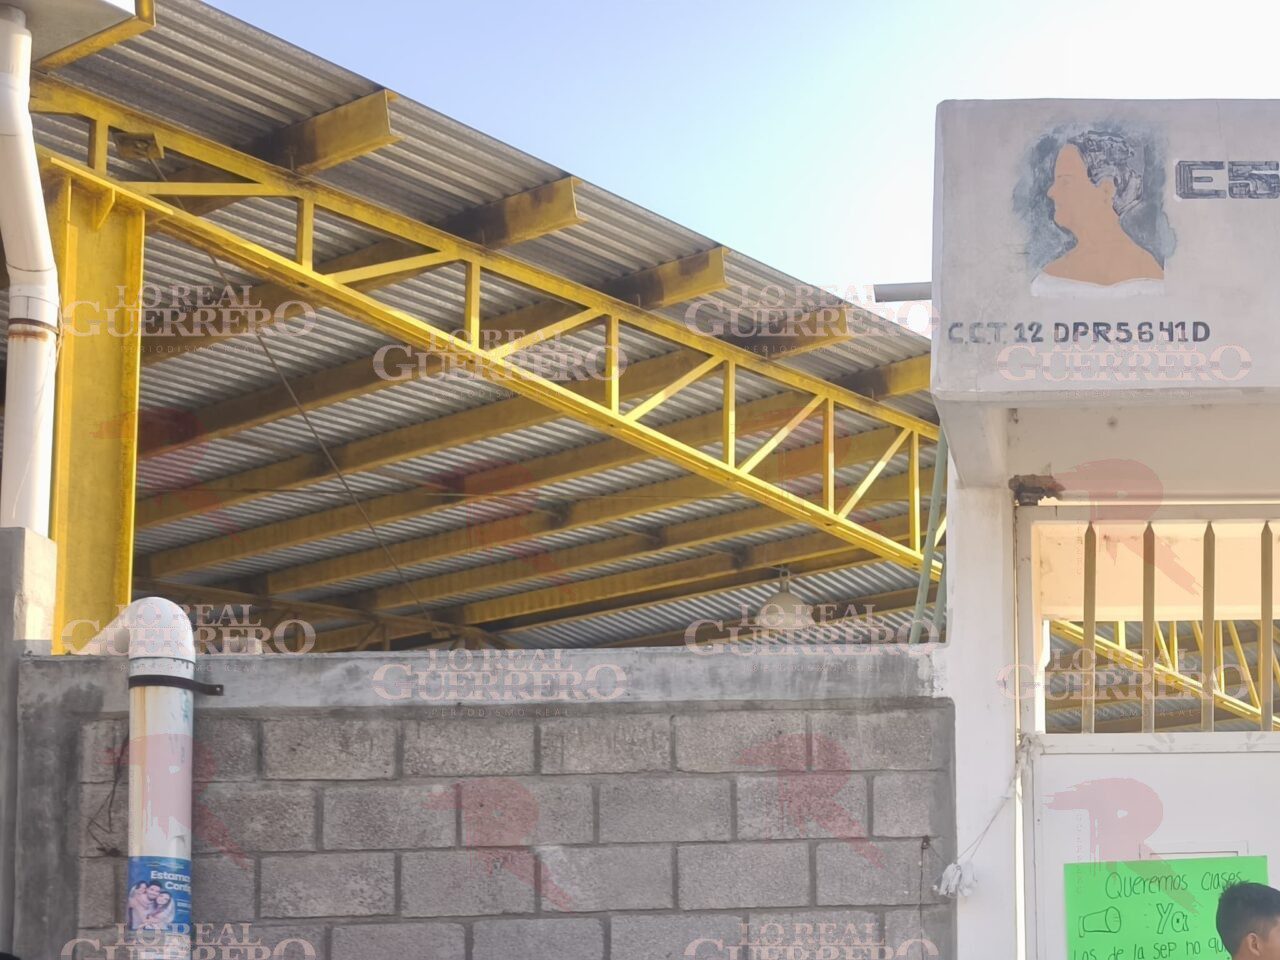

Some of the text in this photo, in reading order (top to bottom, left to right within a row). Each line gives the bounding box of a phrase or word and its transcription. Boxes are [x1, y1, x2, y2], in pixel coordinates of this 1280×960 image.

[1014, 321, 1045, 342] 12
[1105, 871, 1188, 900] Queremos
[1134, 944, 1145, 960] la
[1186, 940, 1200, 955] no
